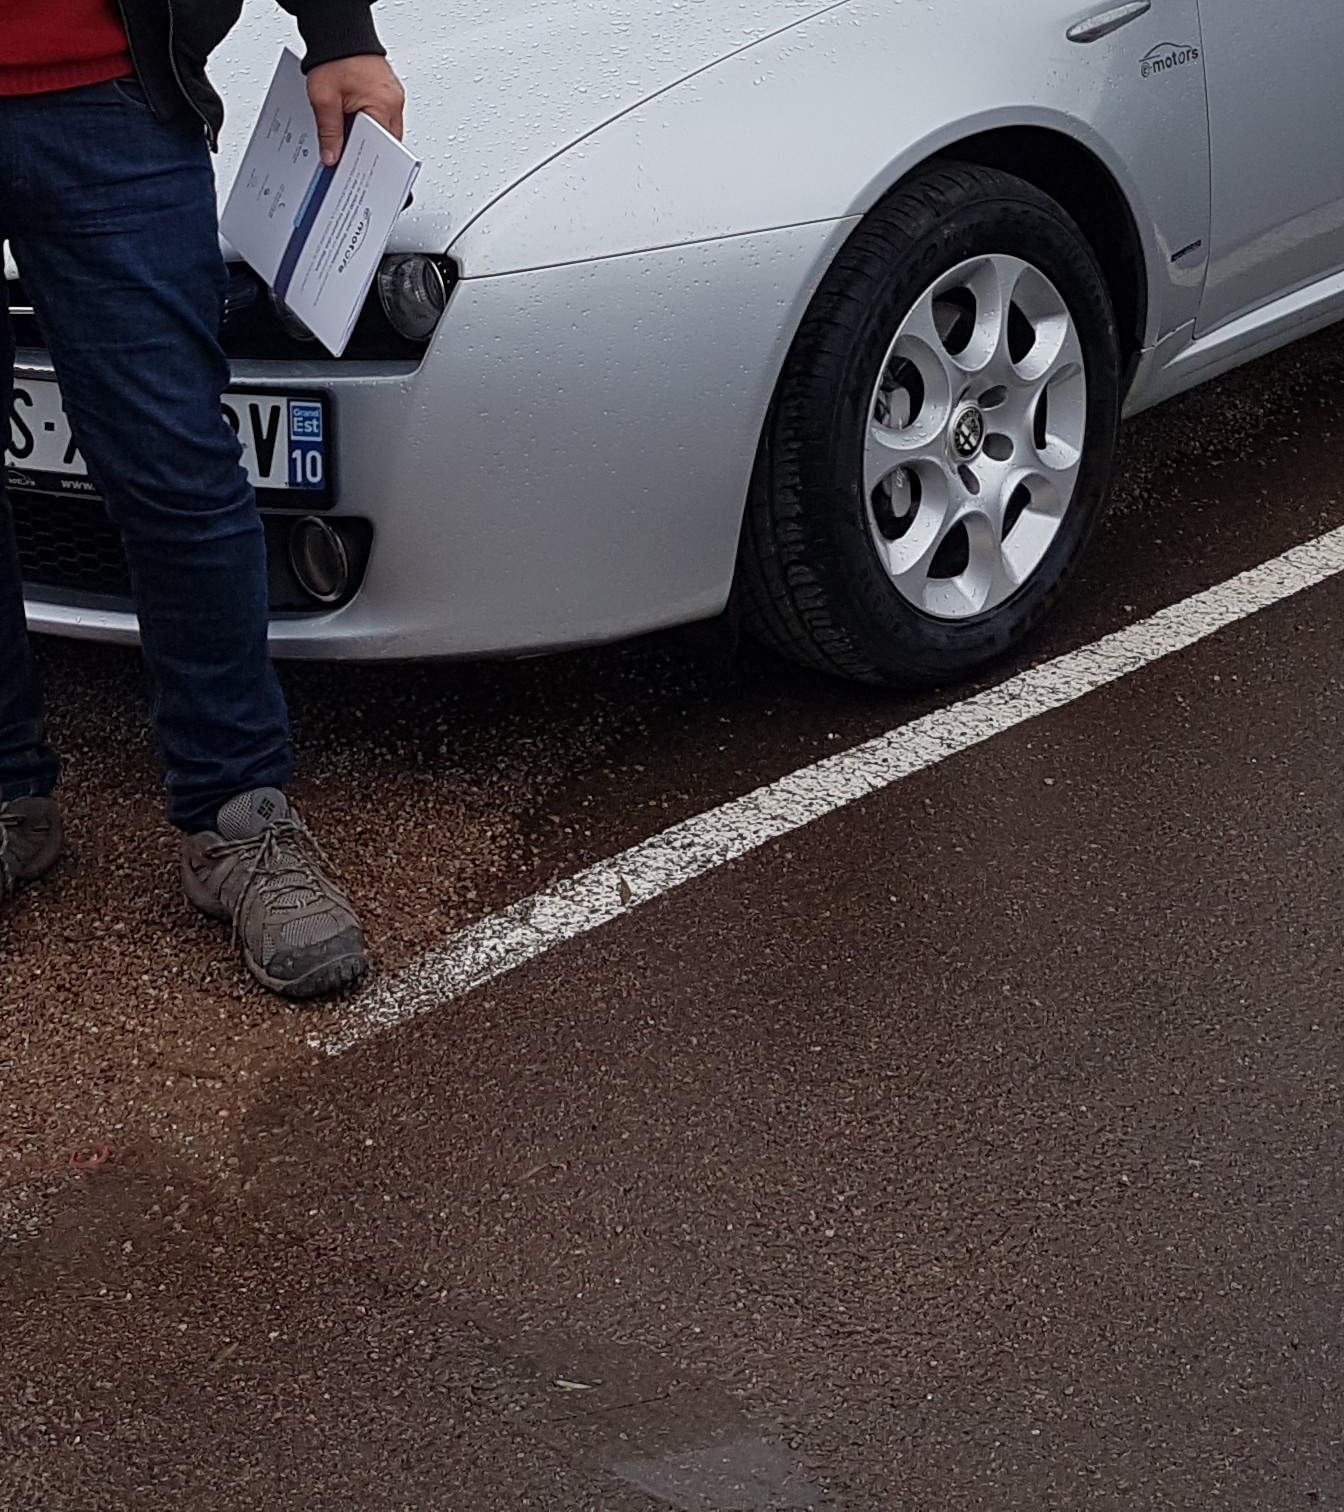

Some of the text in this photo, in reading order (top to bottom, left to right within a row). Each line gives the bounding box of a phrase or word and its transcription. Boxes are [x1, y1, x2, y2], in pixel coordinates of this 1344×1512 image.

[293, 408, 319, 417] Grand
[293, 417, 319, 433] Est
[291, 449, 323, 483] 10
